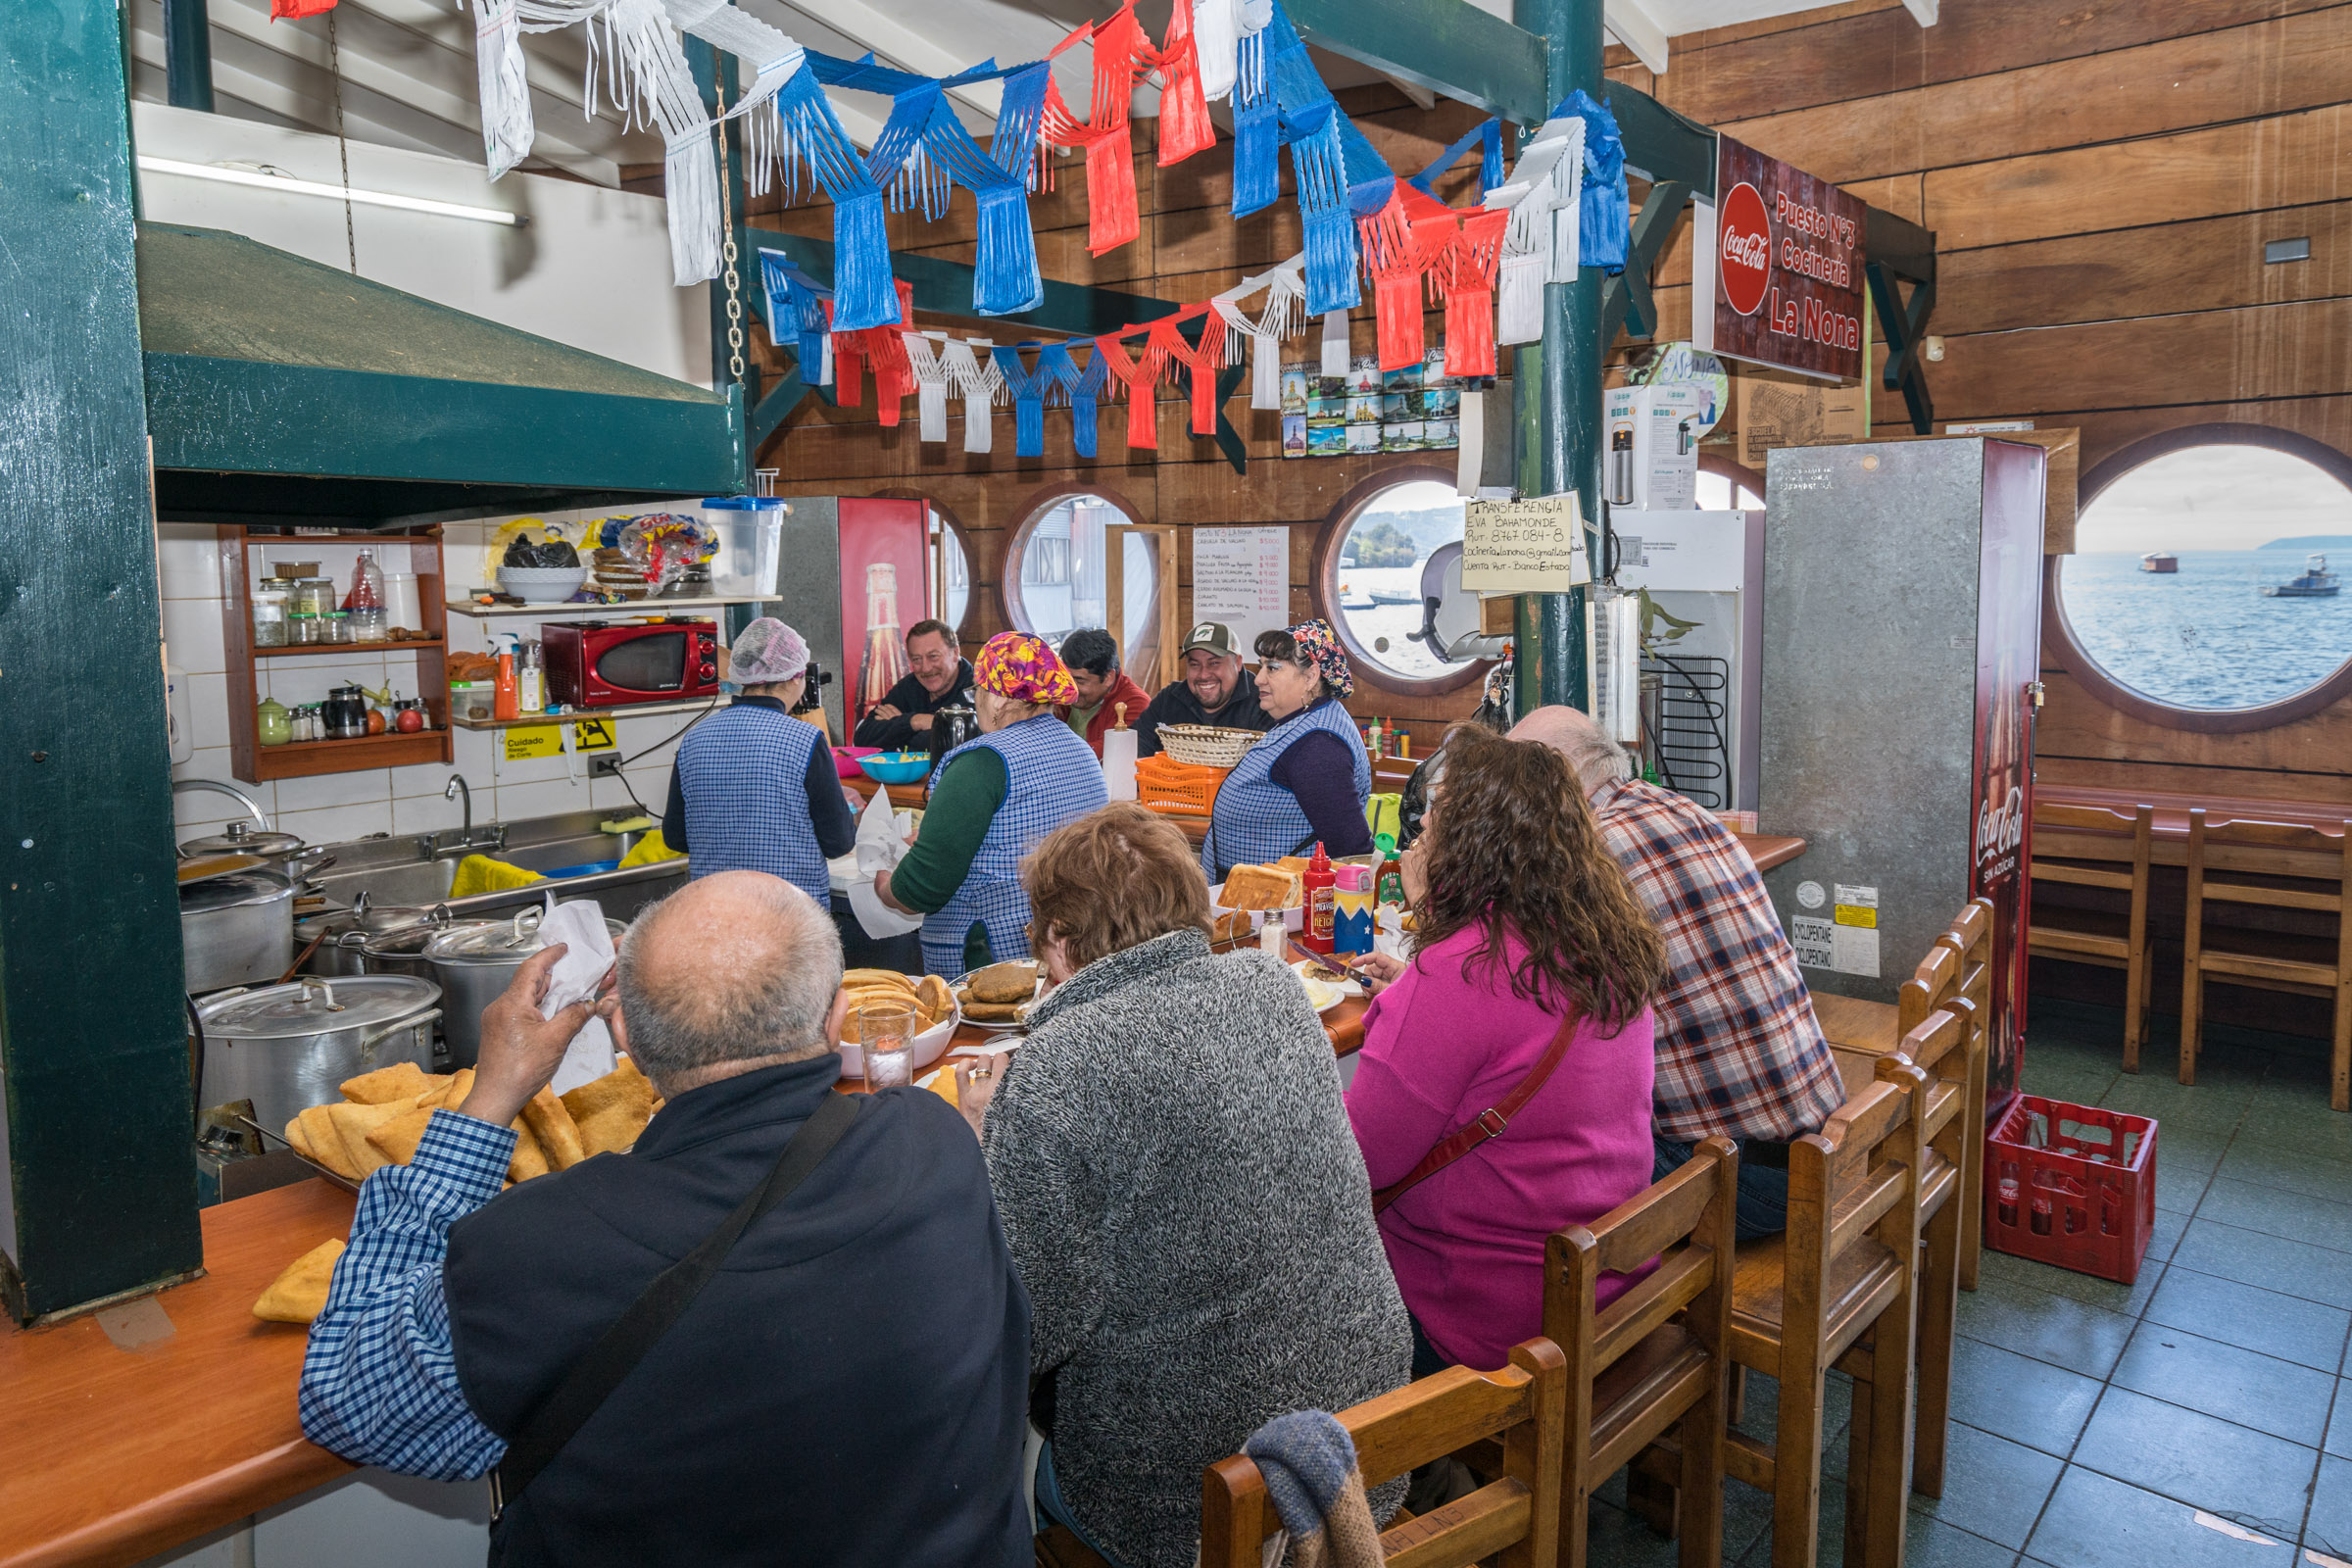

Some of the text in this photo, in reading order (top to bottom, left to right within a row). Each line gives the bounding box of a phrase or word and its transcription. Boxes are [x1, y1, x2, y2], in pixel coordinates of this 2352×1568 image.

[1776, 191, 1828, 238] Puesto
[1723, 224, 1768, 270] Coca-Cola
[1781, 237, 1849, 287] Cocinería
[1770, 287, 1859, 351] La Nona
[1466, 514, 1557, 528] EVA BAHAMONDE
[508, 737, 544, 747] Cuidado
[1976, 786, 2023, 868] Coca-Cola
[1984, 856, 2015, 883] SIN AZÚCAR
